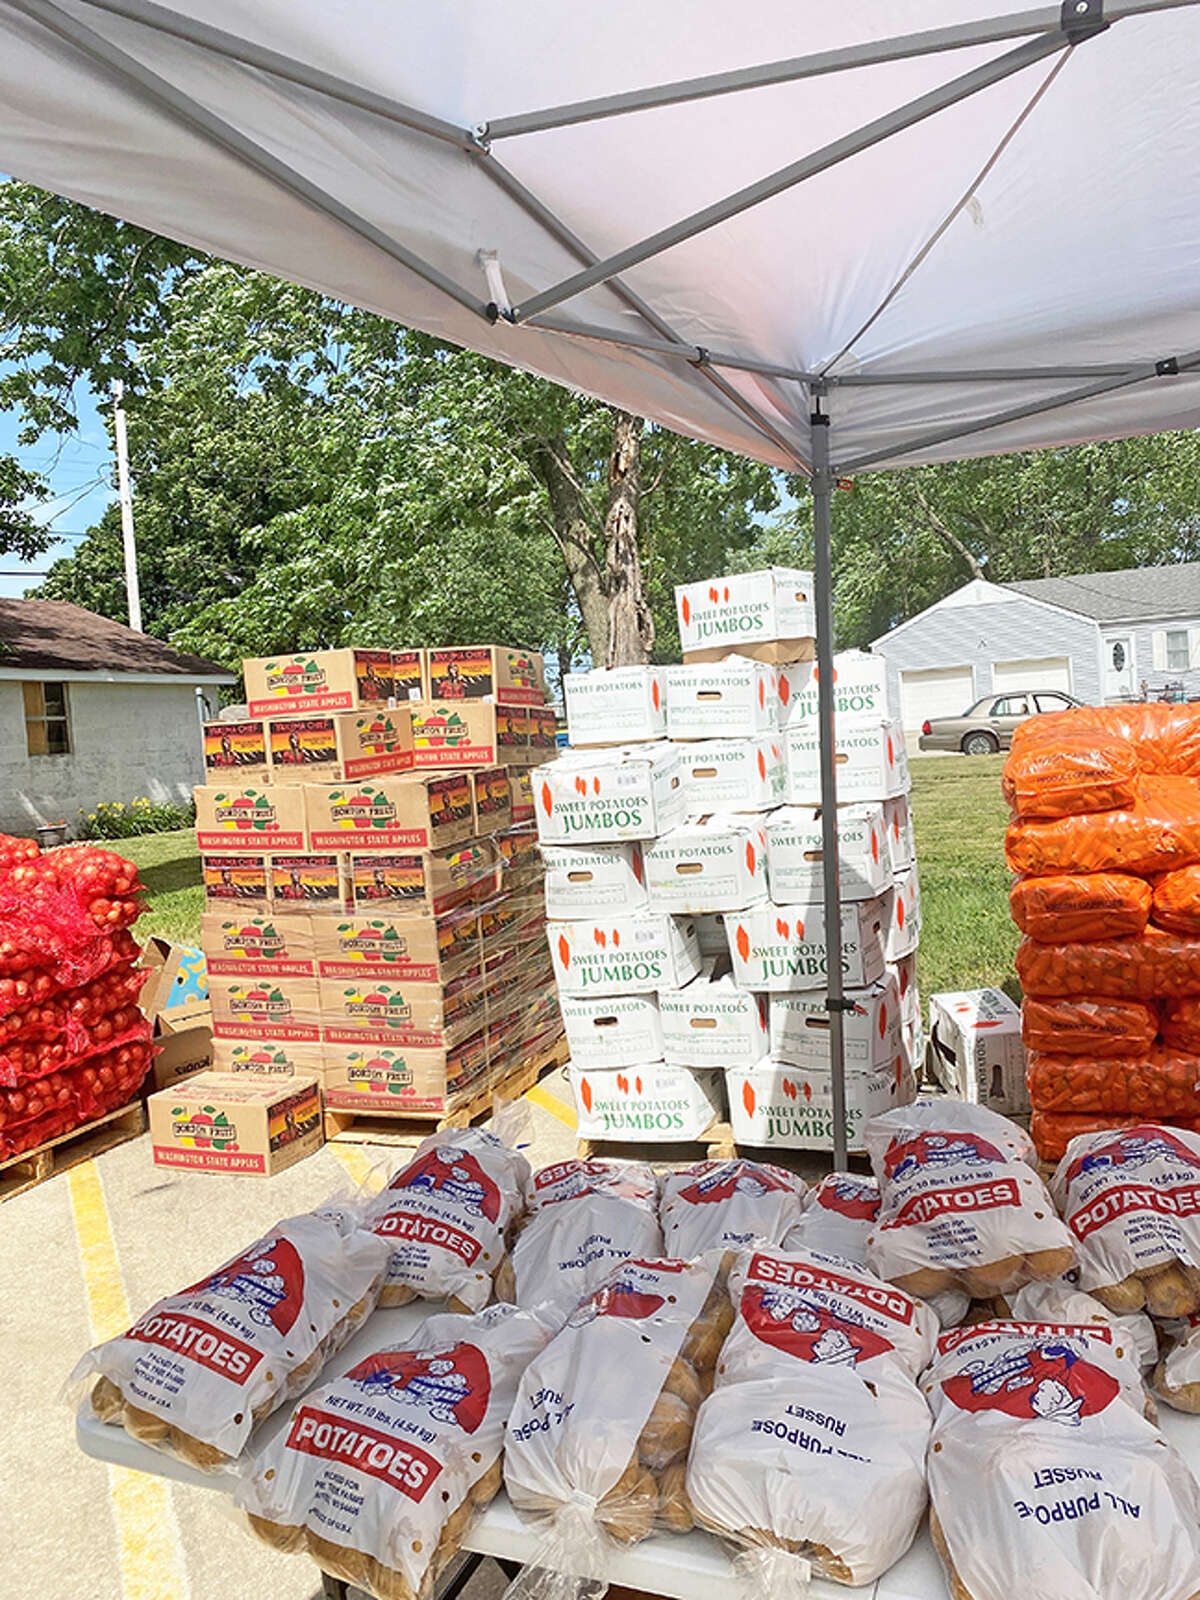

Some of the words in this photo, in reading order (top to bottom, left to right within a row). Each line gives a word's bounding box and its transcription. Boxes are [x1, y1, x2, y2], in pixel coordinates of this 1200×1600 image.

[719, 602, 769, 617] POTATOES
[697, 614, 764, 641] JUMBOS
[596, 681, 643, 692] POTATOES
[700, 677, 750, 687] POTATOES
[801, 695, 875, 720] JUBOS
[694, 752, 746, 764] POTATOES
[554, 801, 586, 814] SWEET
[589, 796, 648, 812] POTATOES
[564, 809, 642, 834] JUMBOS
[771, 836, 803, 847] SWEET
[679, 845, 734, 858] POTATOES
[569, 855, 621, 866] POTATOES
[572, 952, 605, 966] SWEET
[609, 949, 667, 963] POTATOES
[751, 946, 788, 959] SWEET
[792, 942, 857, 956] POTAES
[582, 962, 661, 987] JUMBOS
[660, 1003, 690, 1012] SWEET
[694, 1003, 749, 1014] POTATOES
[593, 1101, 627, 1112] SWEET
[630, 1099, 690, 1111] POTATOES
[758, 1105, 795, 1117] SWEET
[798, 1107, 863, 1120] POTAES
[603, 1112, 684, 1132] JUMBOS
[158, 1151, 205, 1165] WASHINGTON
[205, 1155, 229, 1166] STATE
[229, 1156, 259, 1168] APPLES
[916, 1180, 929, 1189] 10
[975, 1170, 993, 1179] kg)
[1175, 1171, 1194, 1181] kg)
[381, 1217, 476, 1258] OTATOES
[608, 1249, 631, 1258] ALL
[640, 1273, 659, 1282] NET
[757, 1260, 908, 1317] POTATOES
[829, 1299, 843, 1311] 10
[129, 1318, 251, 1375] POTATOES
[325, 1395, 347, 1408] NET
[364, 1406, 377, 1418] 10
[392, 1418, 419, 1434] (4.54
[418, 1428, 438, 1444] kg)
[785, 1404, 847, 1437] RUSSET
[297, 1416, 429, 1489] POTATOES
[1013, 1492, 1100, 1525] PURPOE
[1103, 1491, 1141, 1519] ALL
